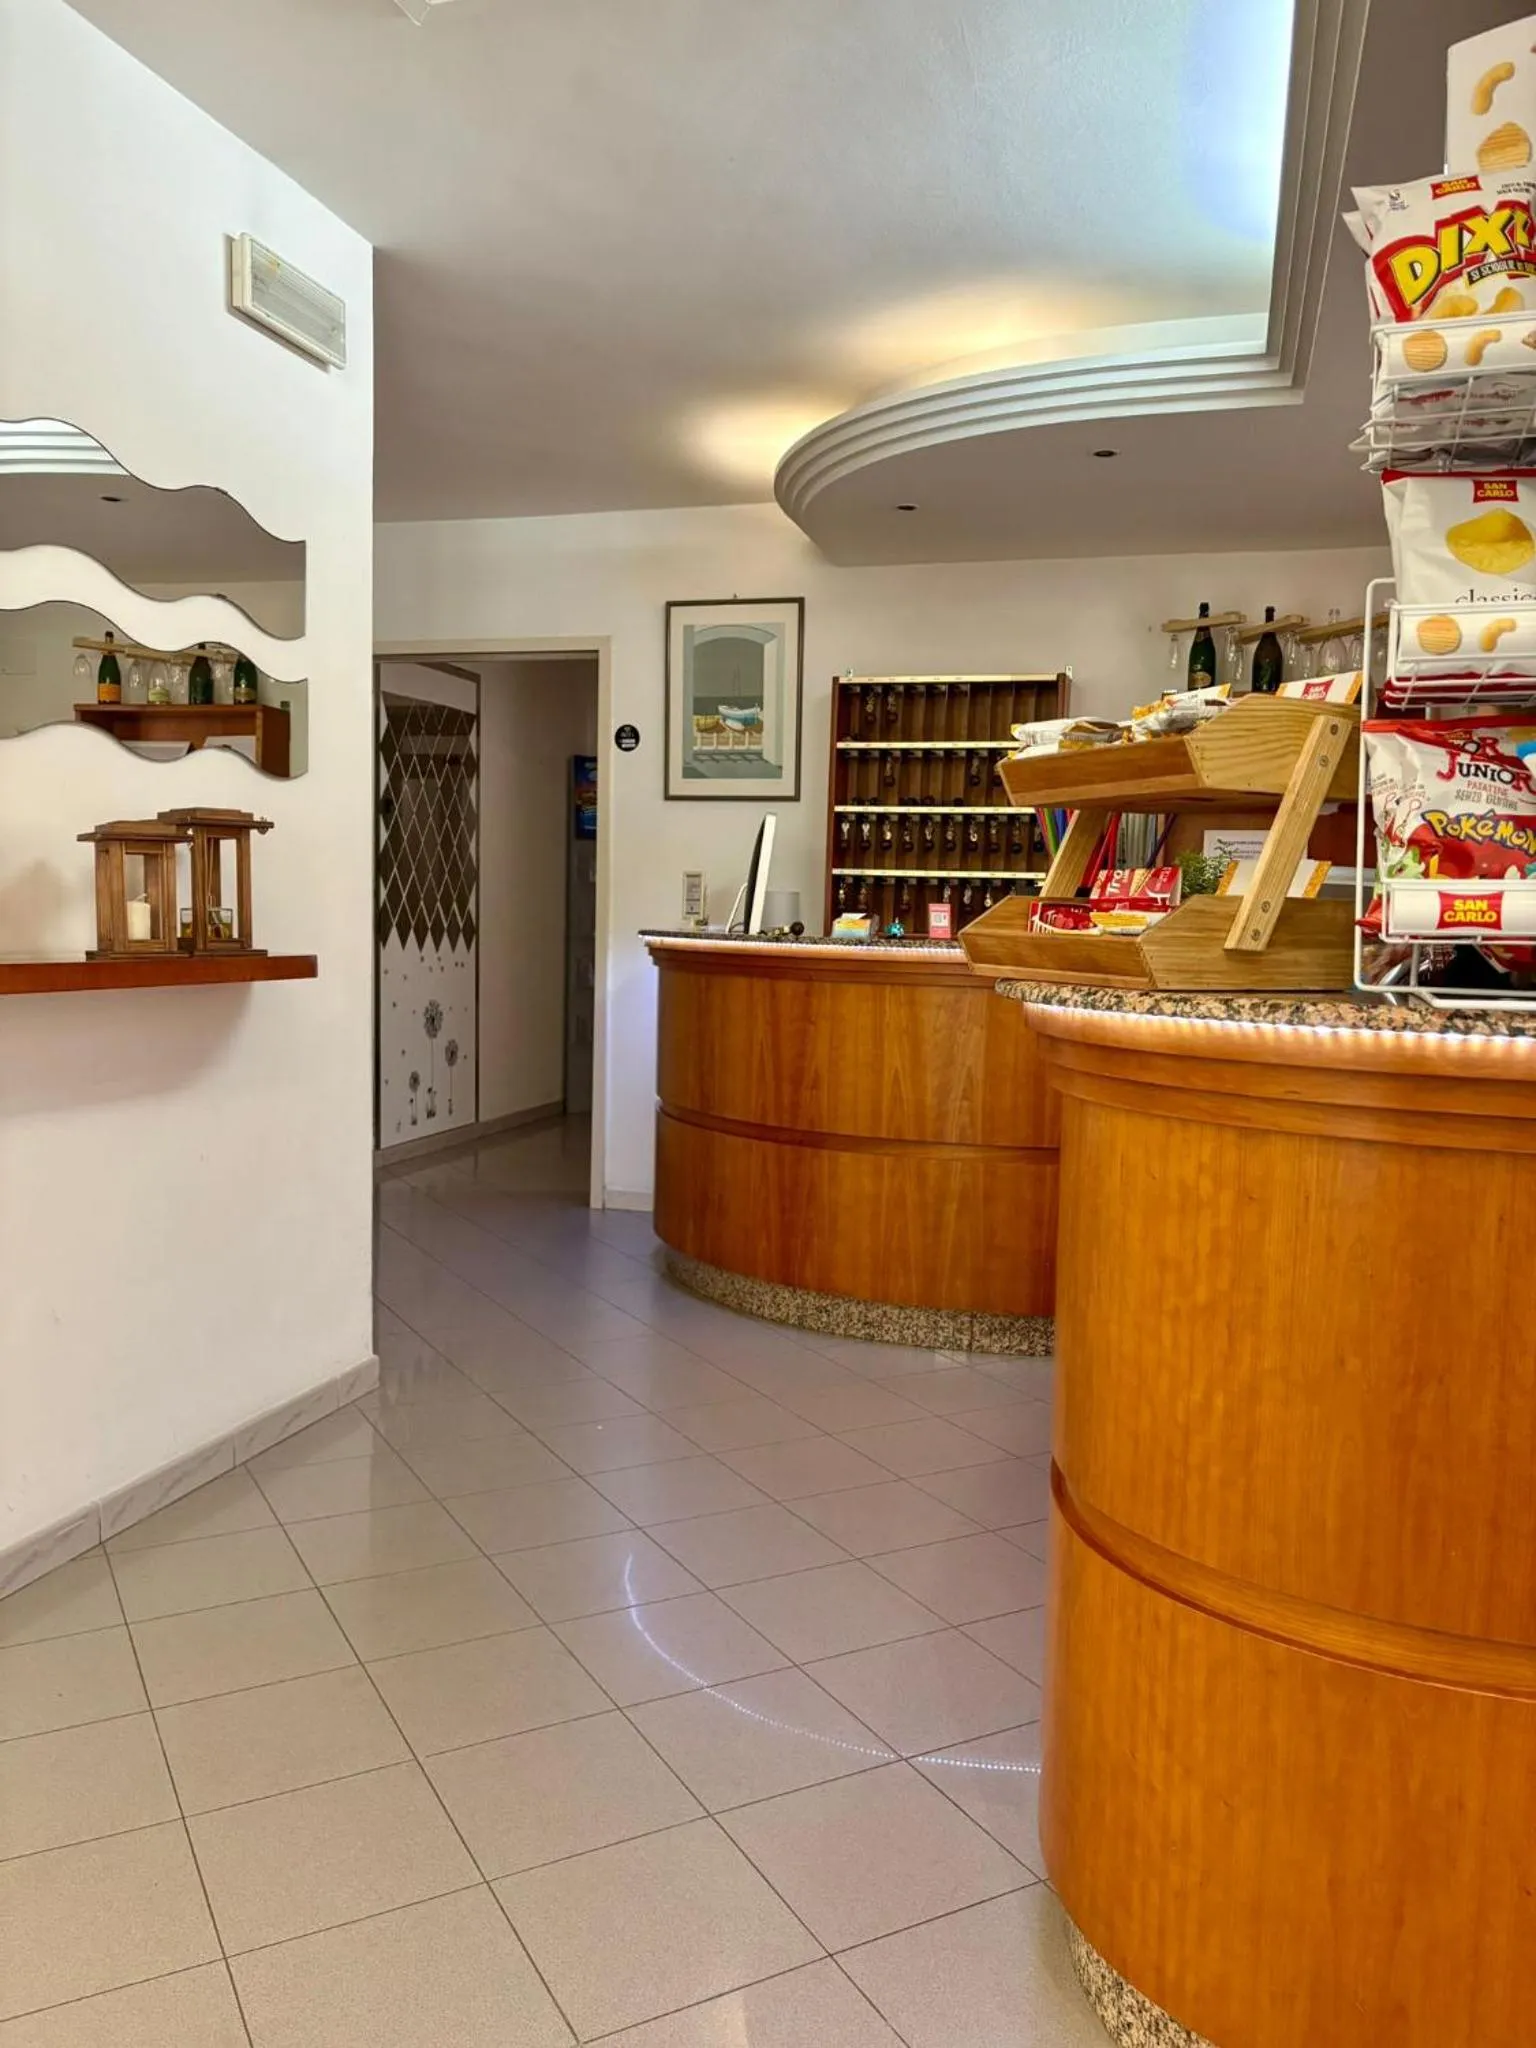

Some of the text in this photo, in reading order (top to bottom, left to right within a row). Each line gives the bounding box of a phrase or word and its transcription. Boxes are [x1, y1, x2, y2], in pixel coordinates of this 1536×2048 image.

[1484, 482, 1507, 490] SAN
[1476, 489, 1515, 498] CARLO
[1455, 588, 1536, 604] classic
[1437, 750, 1536, 796] JUNIOR
[1453, 898, 1488, 911] SAN
[1443, 910, 1498, 923] CARLO
